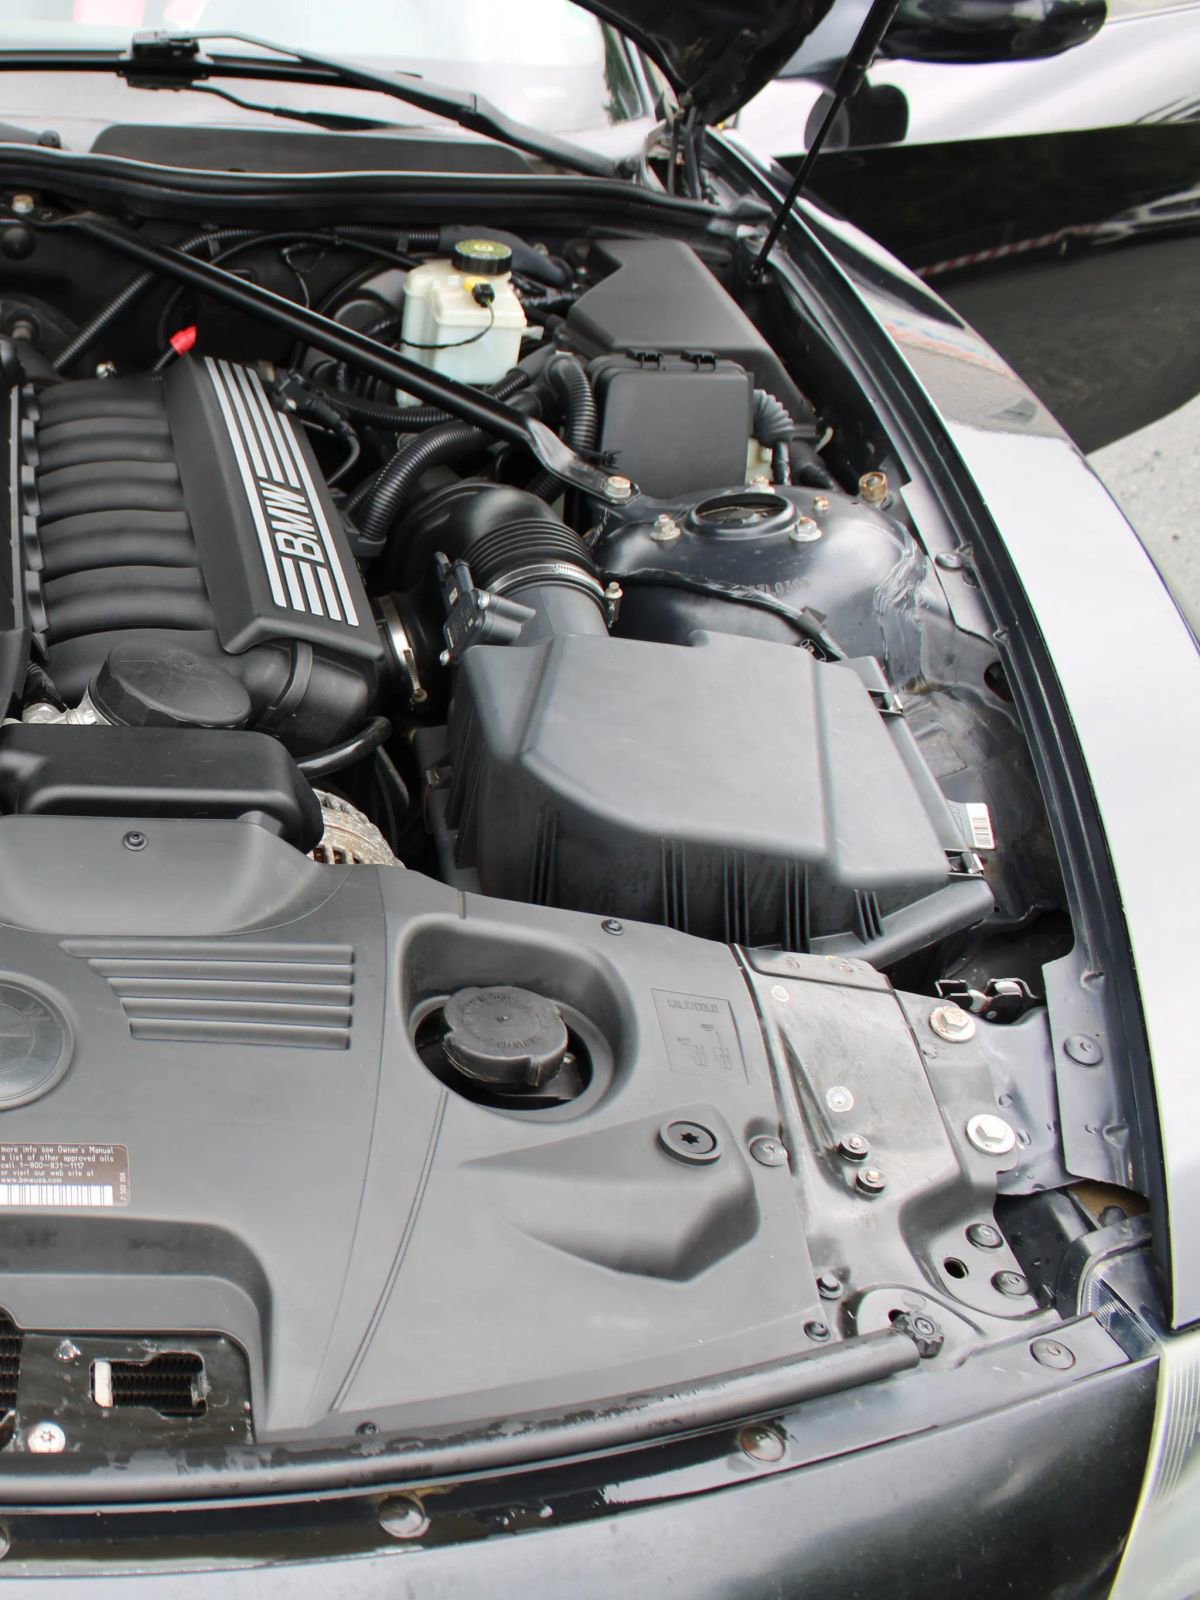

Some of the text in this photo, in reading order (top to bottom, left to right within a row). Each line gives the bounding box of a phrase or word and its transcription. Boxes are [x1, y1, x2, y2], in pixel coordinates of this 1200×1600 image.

[259, 480, 325, 564] BMW
[22, 1145, 38, 1153] info
[57, 1145, 86, 1154] Owner's
[89, 1146, 115, 1154] Manual
[9, 1153, 23, 1161] list
[27, 1153, 36, 1161] of
[39, 1153, 59, 1161] other
[63, 1154, 96, 1163] approved
[99, 1154, 115, 1163] oils
[12, 1169, 30, 1177] visit
[50, 1169, 65, 1177] web
[68, 1169, 83, 1177] site
[86, 1169, 95, 1177] at
